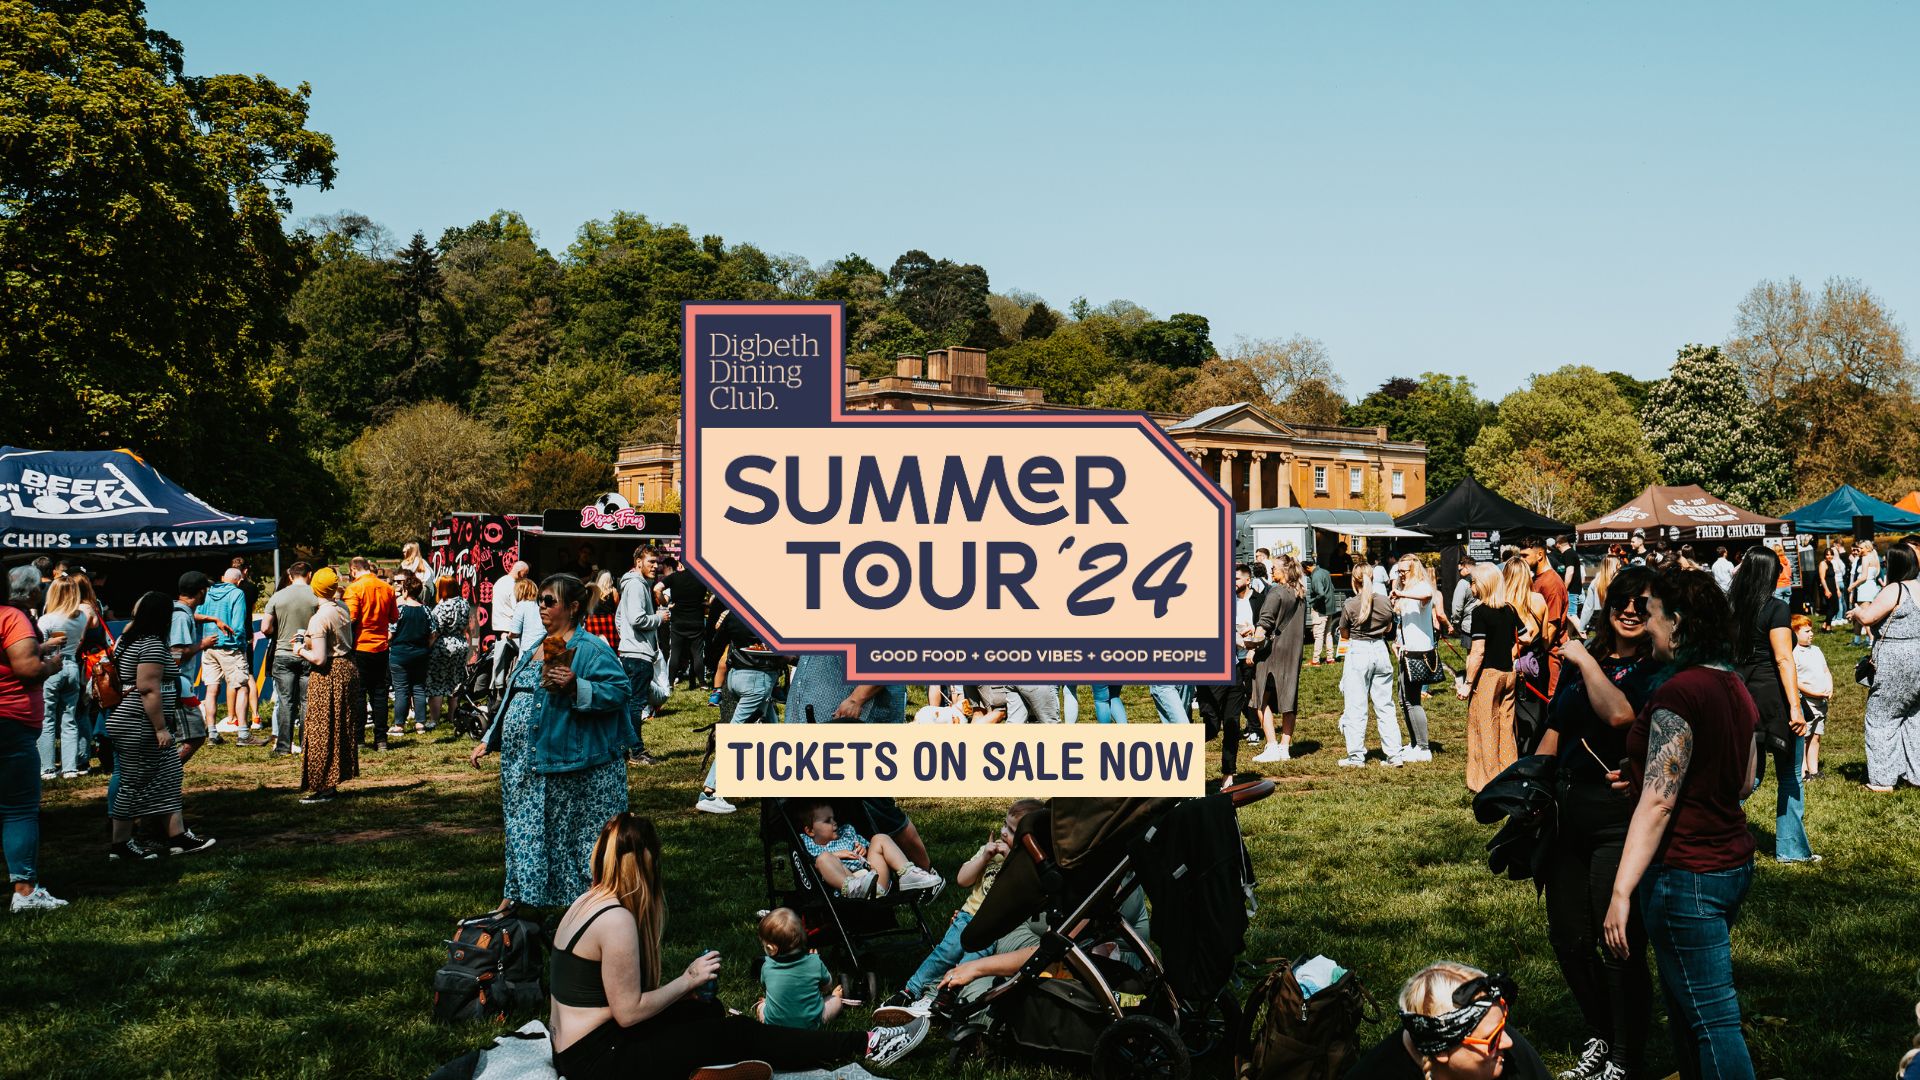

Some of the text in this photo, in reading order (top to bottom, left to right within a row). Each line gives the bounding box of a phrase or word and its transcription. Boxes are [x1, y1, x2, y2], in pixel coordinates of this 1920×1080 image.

[21, 468, 120, 495] BEEF
[581, 506, 646, 531] Disco Fries
[2, 529, 249, 548] CHIPS STEAK WRAPS
[1695, 525, 1725, 539] FRIED
[1726, 524, 1766, 538] CHICKEN
[455, 548, 477, 587] Fries
